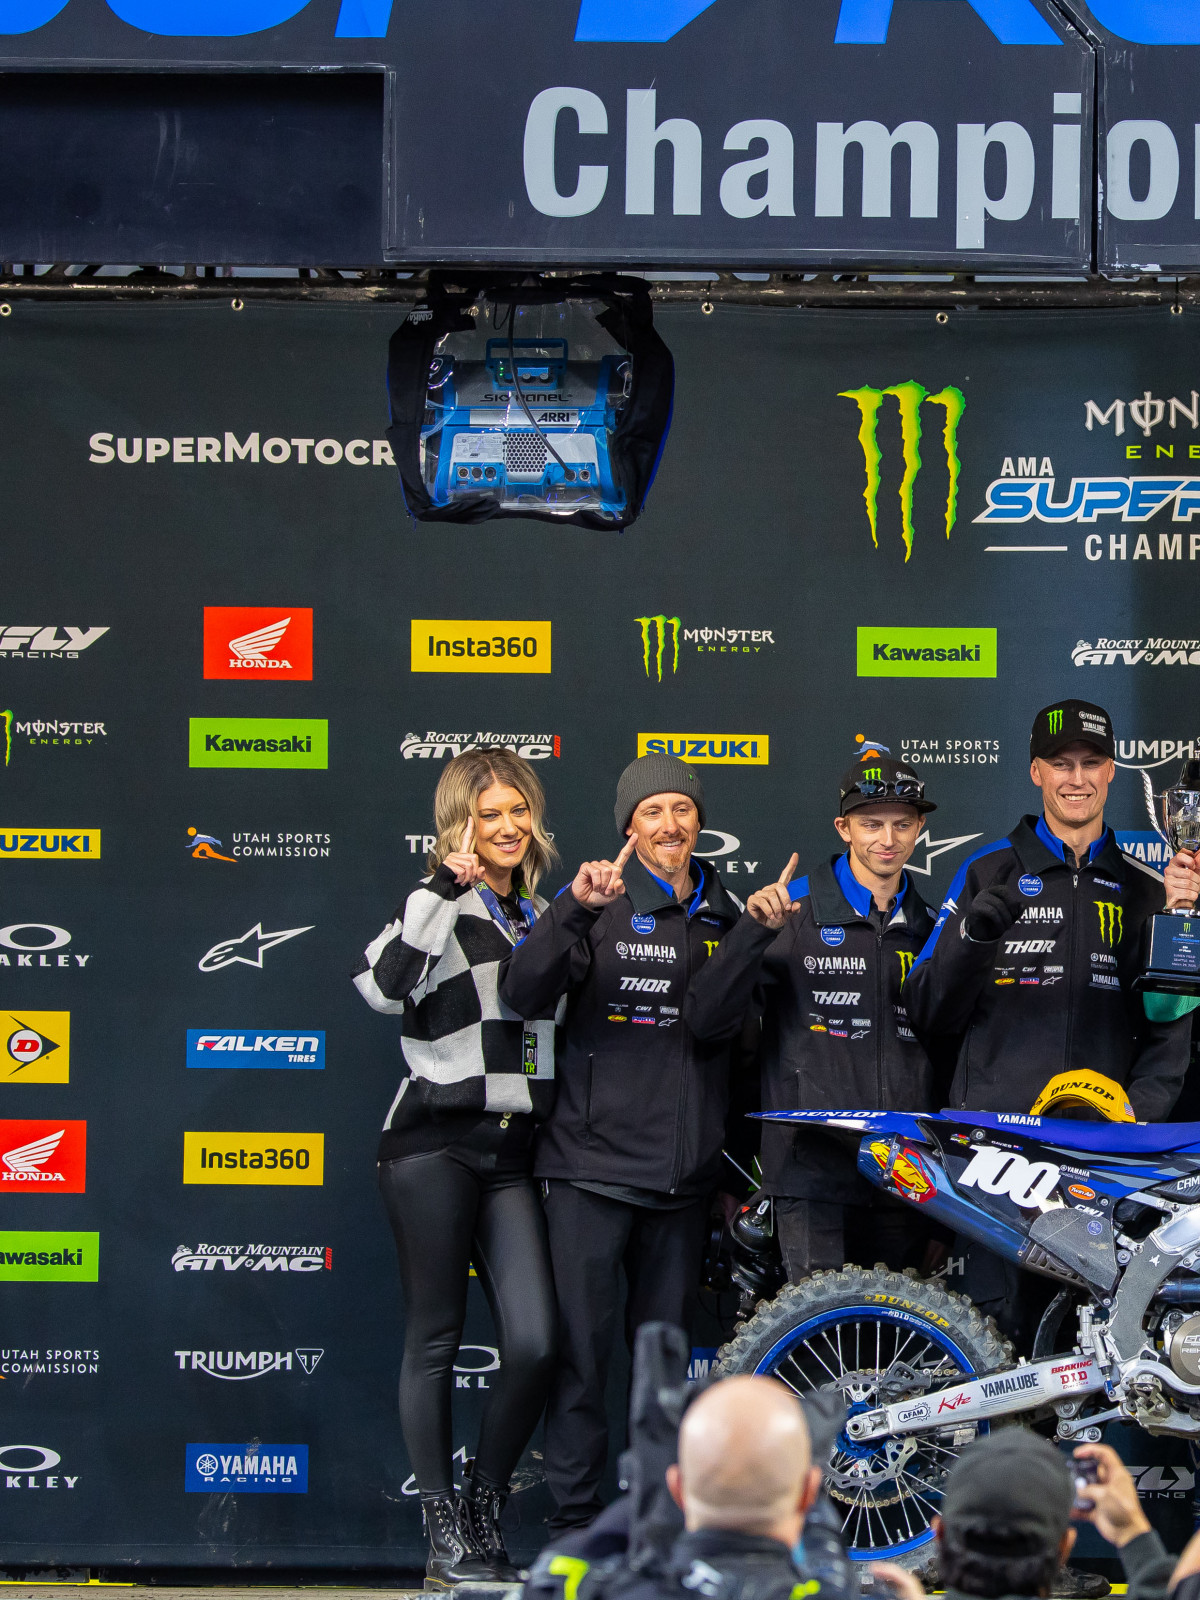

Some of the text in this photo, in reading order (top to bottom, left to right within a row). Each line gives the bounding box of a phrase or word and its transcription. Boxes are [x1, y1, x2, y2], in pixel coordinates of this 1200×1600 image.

[537, 412, 570, 423] ARRI
[88, 432, 397, 466] SUPERMOTOCR
[1000, 456, 1055, 477] AMA
[683, 626, 775, 645] MONSTER
[1095, 637, 1142, 650] ROCKY
[428, 635, 538, 659] Insta360
[697, 645, 761, 653] ENERGY
[872, 643, 981, 663] Kawasaki
[229, 658, 293, 669] HONDA
[1085, 712, 1107, 724] YAMAHA
[16, 718, 107, 736] MONSTER
[205, 734, 312, 753] Kawasaki
[424, 732, 553, 744] ROCKY MOUNTAIN
[901, 739, 999, 751] UTAH SPORTS
[646, 739, 758, 758] SUZUKI
[1115, 740, 1195, 762] UMPH
[901, 752, 999, 764] COMMISSION
[0, 835, 90, 853] UZUKI
[233, 833, 331, 845] UTAH SPORTS
[233, 846, 330, 858] COMMISSION
[1123, 842, 1175, 862] YAMA
[1020, 906, 1064, 919] AMAHA
[628, 943, 677, 959] YAMAHA
[1004, 939, 1056, 954] THOR
[0, 954, 90, 967] AKLEY
[620, 955, 674, 964] RACING
[816, 956, 867, 971] YAMAHA
[619, 976, 671, 994] THOR
[812, 990, 861, 1006] THOR
[194, 1035, 319, 1052] FALKEN
[287, 1054, 316, 1063] TIRES
[1051, 1082, 1114, 1102] DUNLOP
[996, 1114, 1042, 1127] YAMAHA
[201, 1147, 310, 1170] Insta360
[1, 1172, 66, 1181] HONDA
[957, 1145, 1062, 1208] 100
[1067, 1165, 1090, 1178] YAMAHA
[1176, 1175, 1200, 1191] CRM
[0, 1248, 83, 1266] wasaki
[196, 1243, 323, 1256] ROCKY MOUNTAIN
[872, 1294, 950, 1328] DUNLOP
[2, 1350, 100, 1360] UTAH SPORTS
[175, 1351, 292, 1374] TRIUMPH
[1, 1363, 98, 1373] COMMISSION
[1051, 1359, 1093, 1375] BRAKING
[980, 1372, 1039, 1399] YAMALUBE
[937, 1392, 972, 1414] Kite
[903, 1408, 924, 1420] AFAM
[220, 1457, 298, 1477] YAMAHA
[6, 1476, 79, 1488] KLEY
